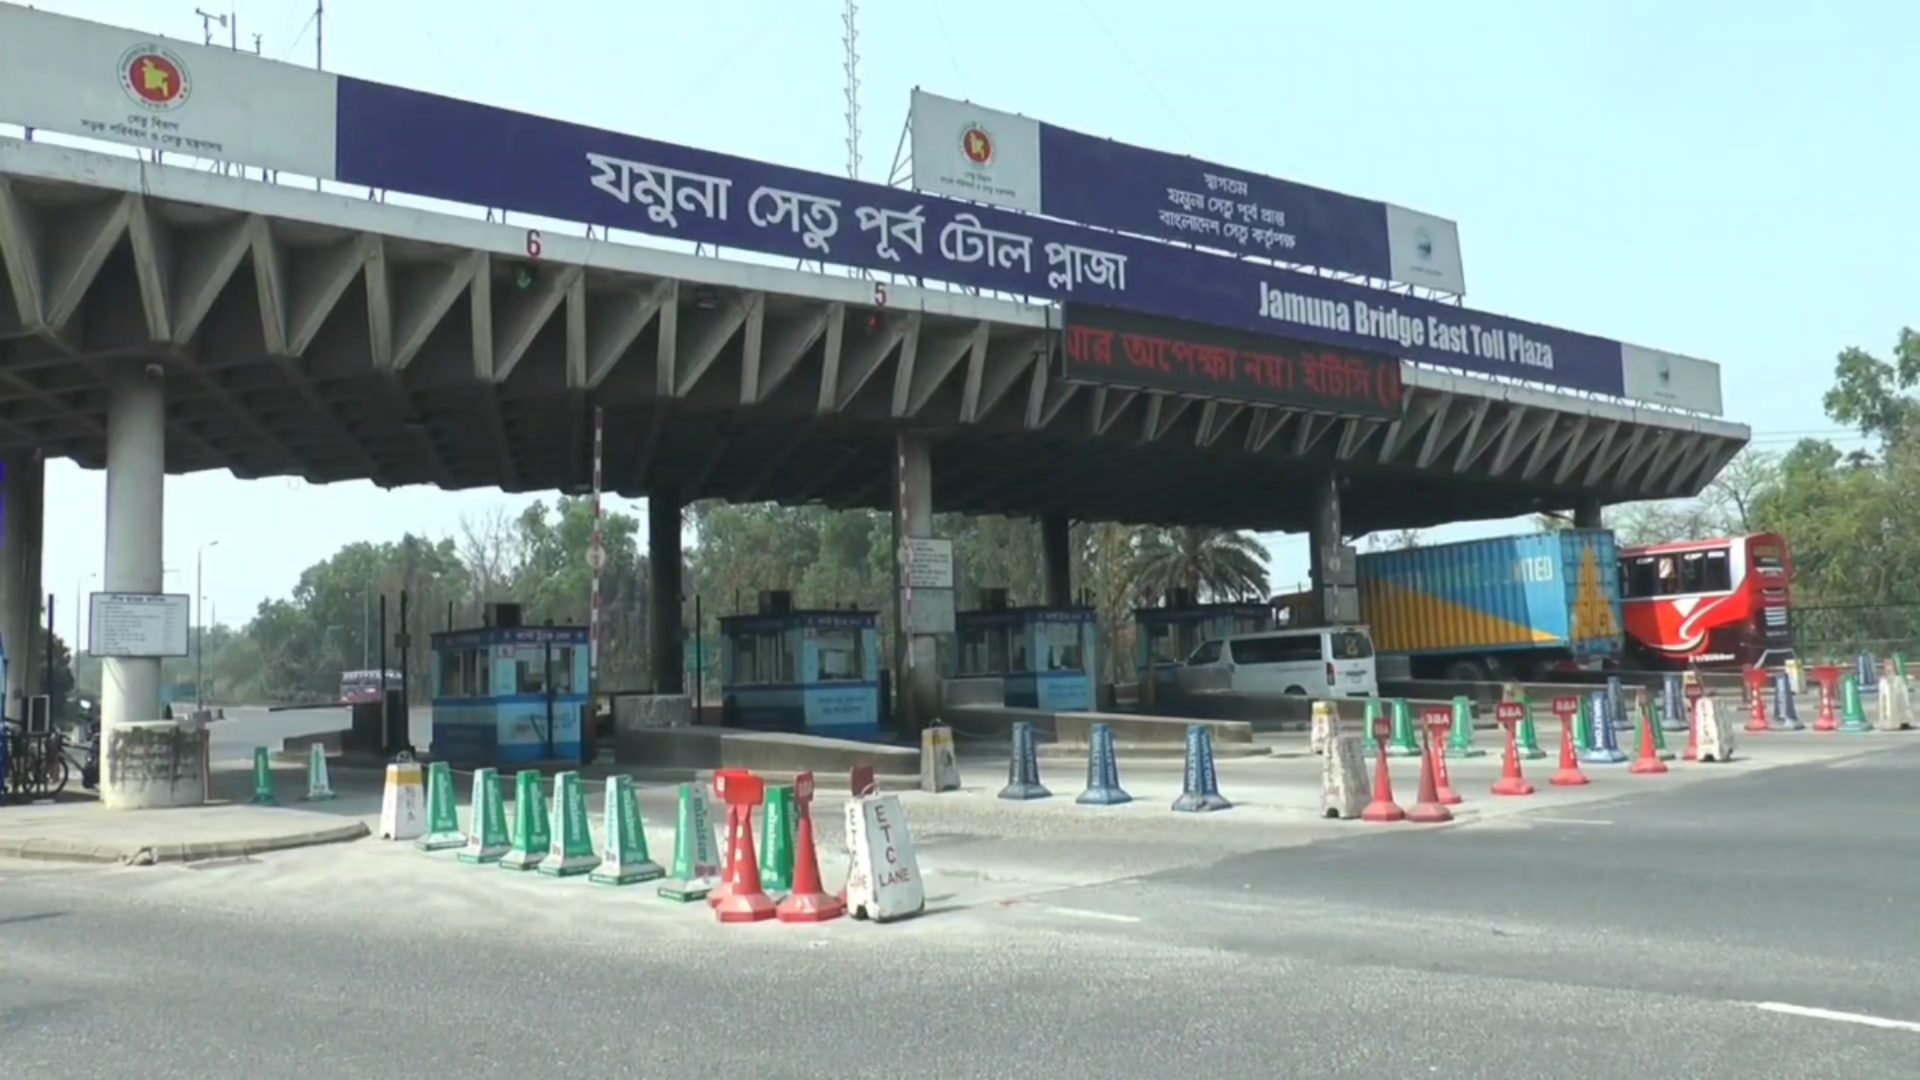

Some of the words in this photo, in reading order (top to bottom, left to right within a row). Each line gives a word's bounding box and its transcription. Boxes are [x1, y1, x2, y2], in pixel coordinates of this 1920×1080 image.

[586, 152, 733, 229] যমুনা
[748, 185, 841, 254] সেতু
[854, 203, 927, 263] পূর্ব
[940, 213, 1034, 274] টোল
[1043, 242, 1128, 292] প্লাজা
[1158, 209, 1220, 236] বাংলাদেশ
[1223, 222, 1249, 245] সেতু
[1207, 197, 1234, 220] সেতু
[527, 228, 541, 257] 6
[874, 281, 887, 307] 5
[1259, 280, 1351, 333] Jamuna
[1353, 300, 1425, 348] Bridge
[1428, 315, 1469, 355] East
[1469, 324, 1506, 361] Toll
[1507, 332, 1555, 371] Plaza
[1121, 333, 1237, 384] অপেক্ষা
[1593, 697, 1604, 748] WALTON
[1187, 732, 1198, 792] WALTON
[1200, 733, 1213, 792] WALTON
[878, 867, 911, 888] LANE
